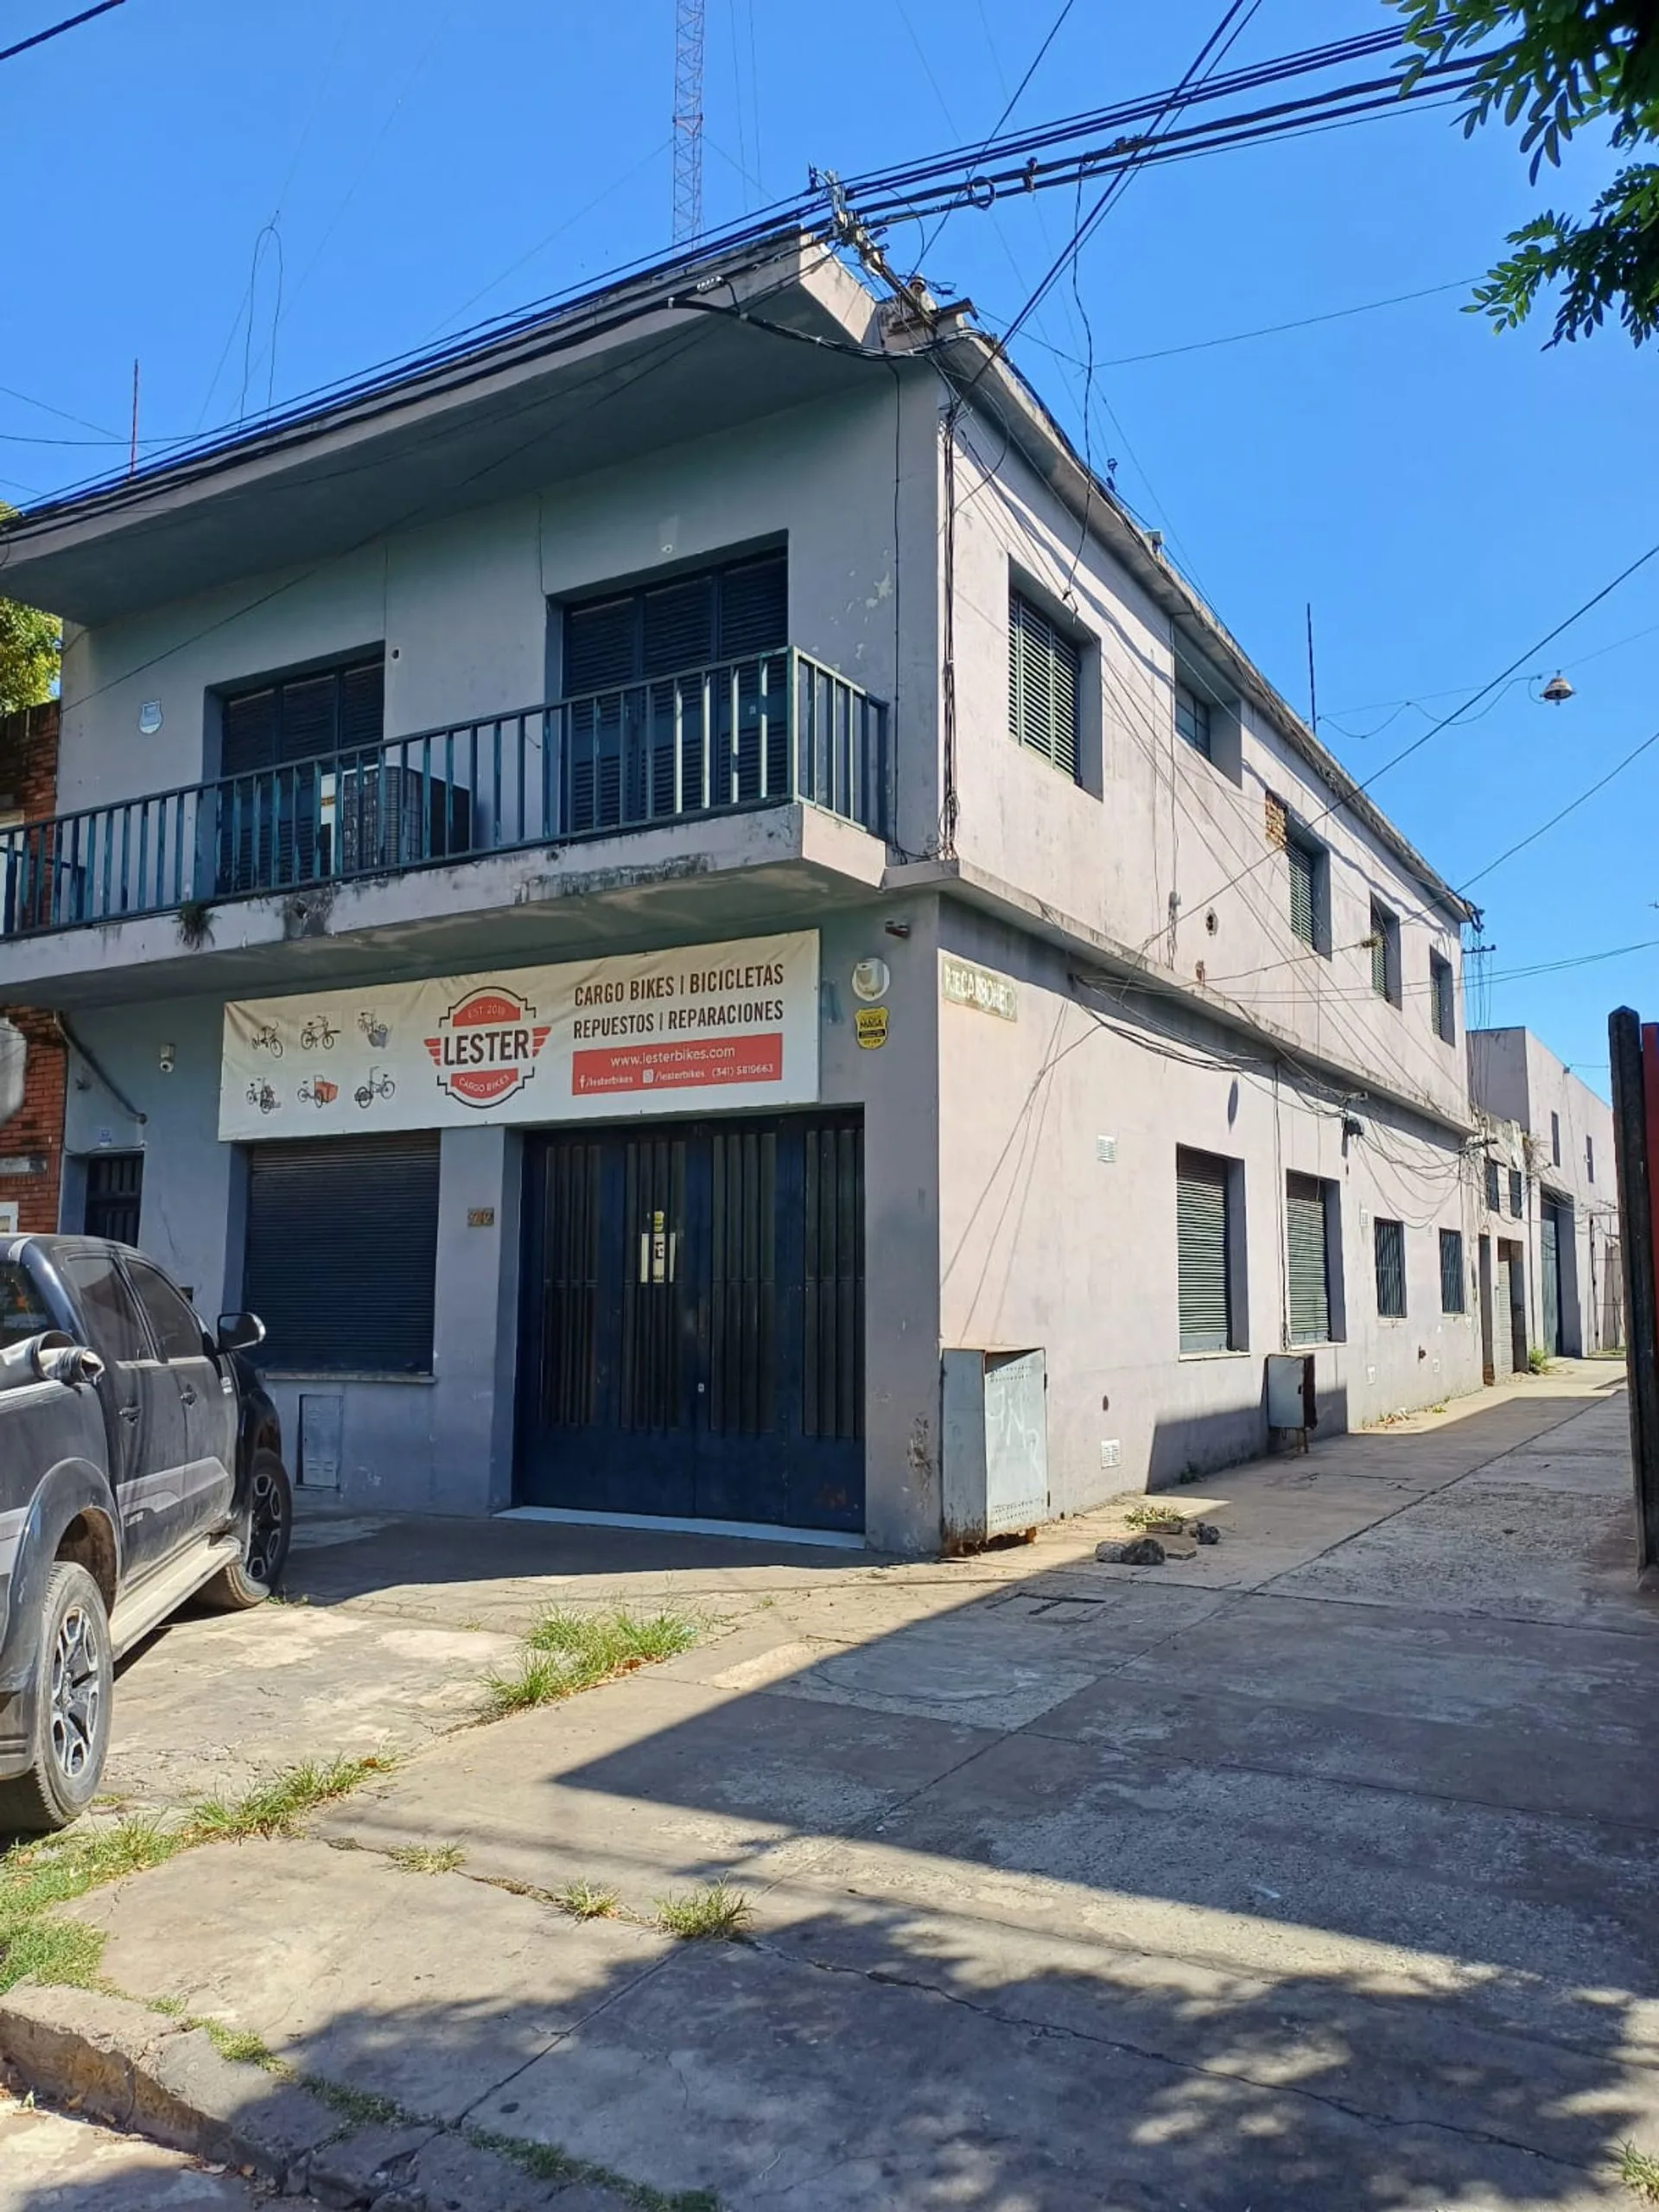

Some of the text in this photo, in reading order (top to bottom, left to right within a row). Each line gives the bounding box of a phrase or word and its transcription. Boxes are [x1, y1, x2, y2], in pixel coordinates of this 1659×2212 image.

[575, 983, 624, 1007] CARGO
[630, 976, 675, 1001] BIKES
[690, 963, 784, 994] BICICLETAS
[574, 1013, 654, 1039] REPUESTOS
[669, 1000, 784, 1030] REPARACIONES
[444, 1029, 529, 1066] LESTER
[610, 1046, 735, 1068] www.lesterbikes.com
[459, 1074, 510, 1093] CARGO BIKES
